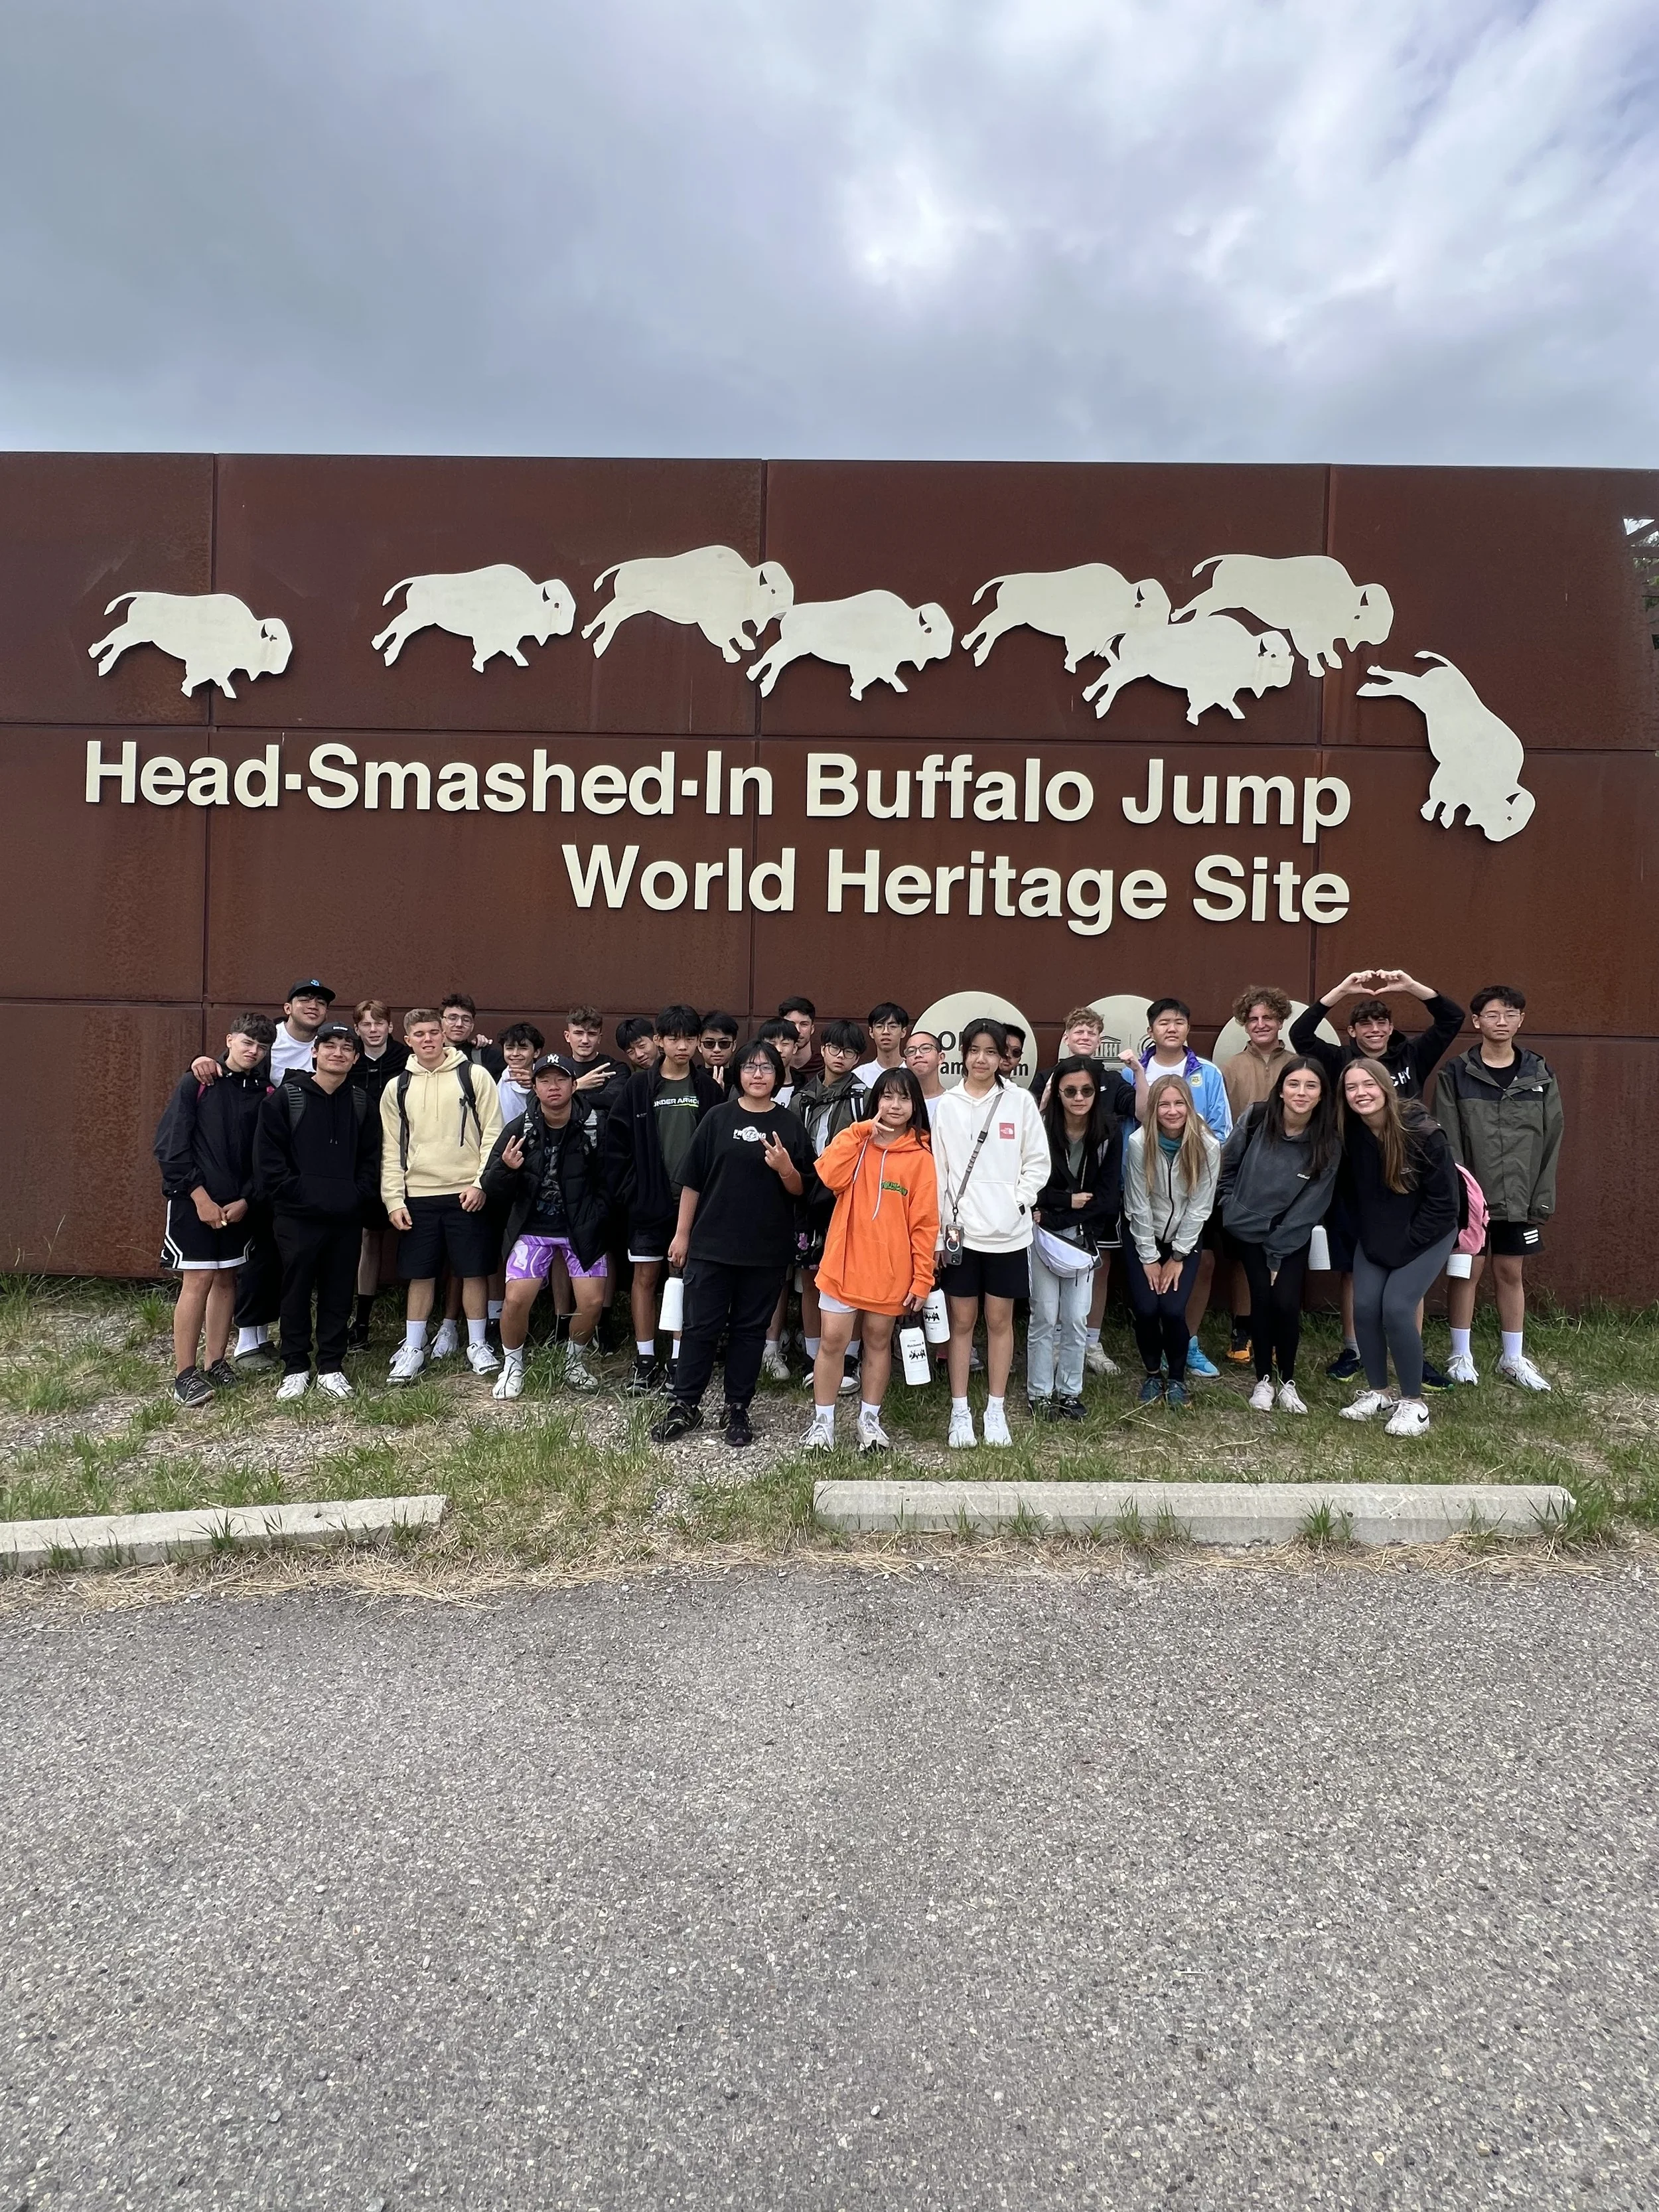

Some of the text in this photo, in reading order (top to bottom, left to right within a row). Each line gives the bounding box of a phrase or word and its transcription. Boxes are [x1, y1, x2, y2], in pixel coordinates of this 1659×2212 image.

[86, 740, 1351, 844] Head-Smashed-In Buffalo Jump
[561, 844, 1350, 936] World Heritage Site
